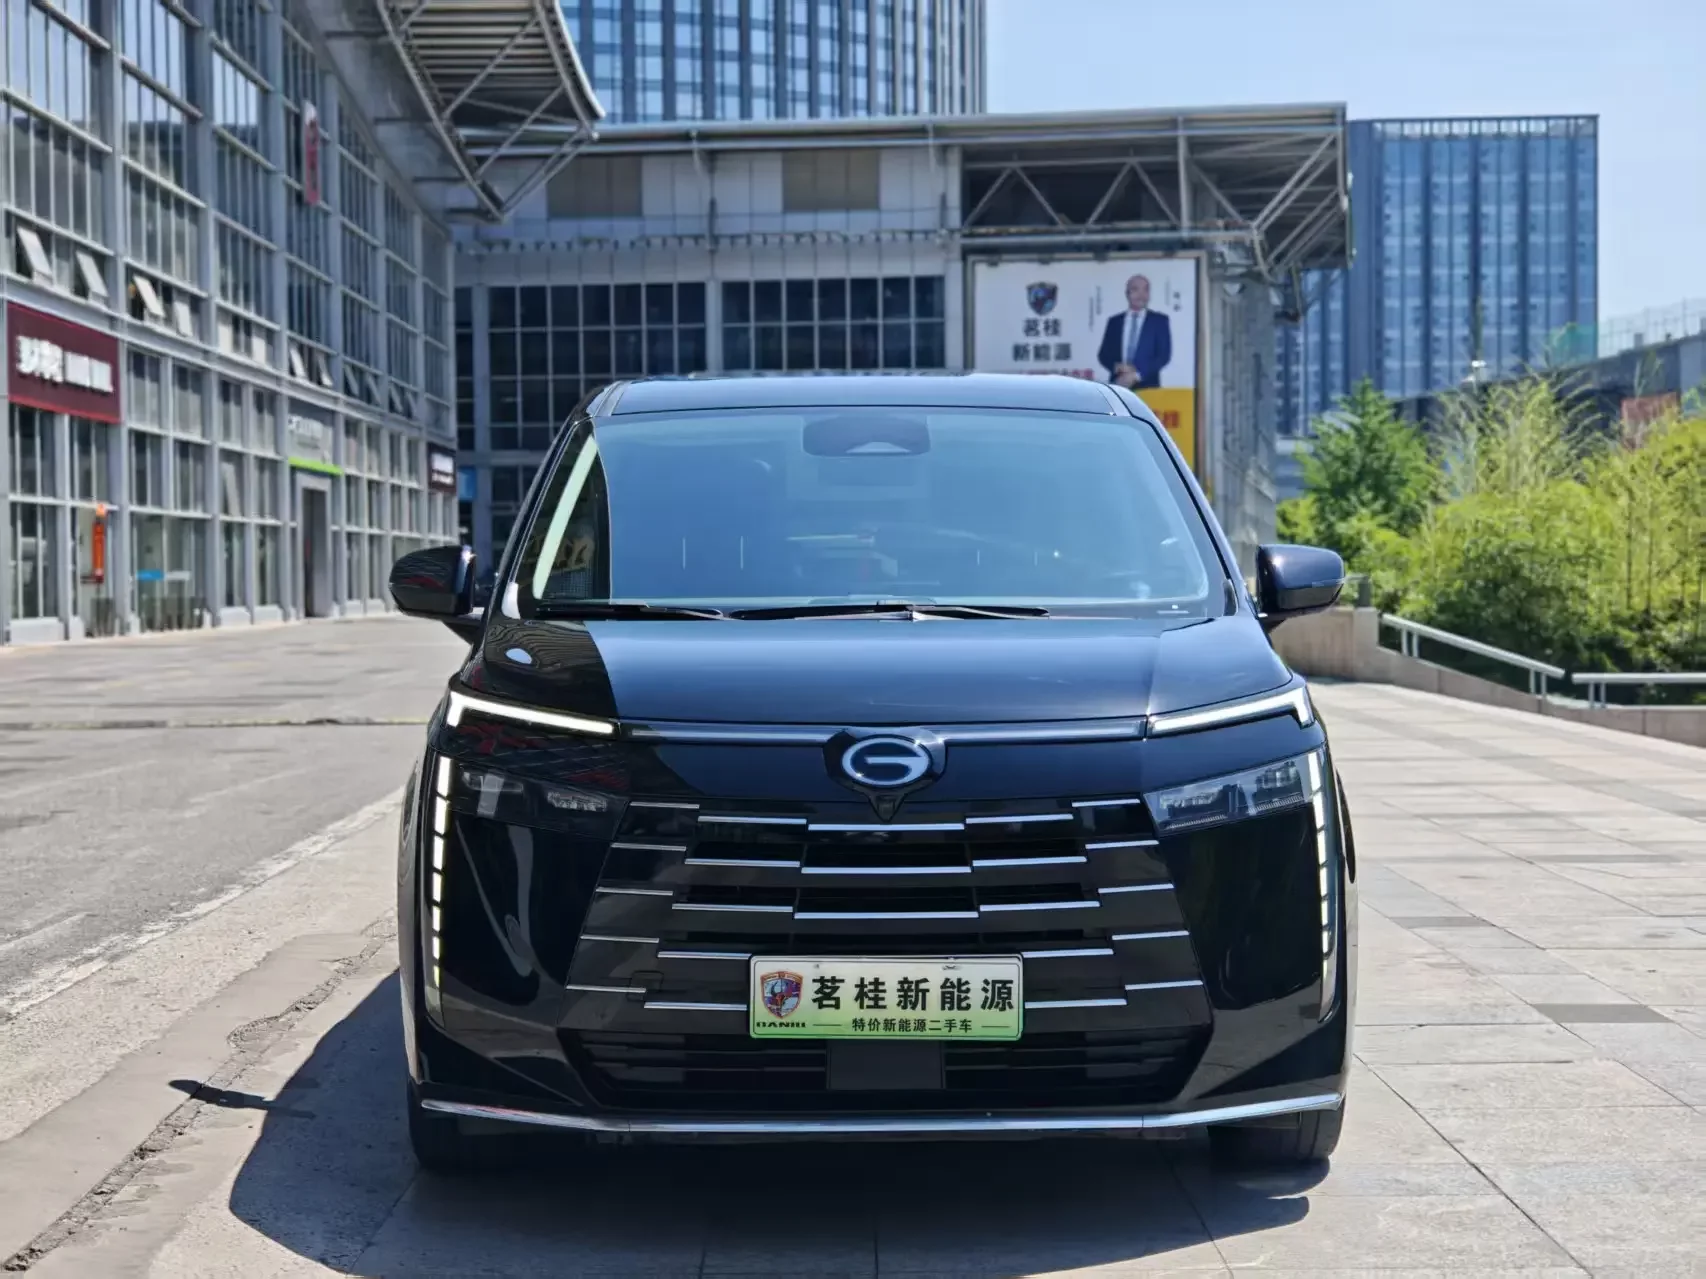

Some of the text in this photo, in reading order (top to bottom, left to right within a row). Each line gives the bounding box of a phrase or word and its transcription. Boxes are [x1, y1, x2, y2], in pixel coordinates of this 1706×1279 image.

[811, 976, 1015, 1012] 茗桂新能源
[851, 1018, 973, 1033] 特价新能源二手车
